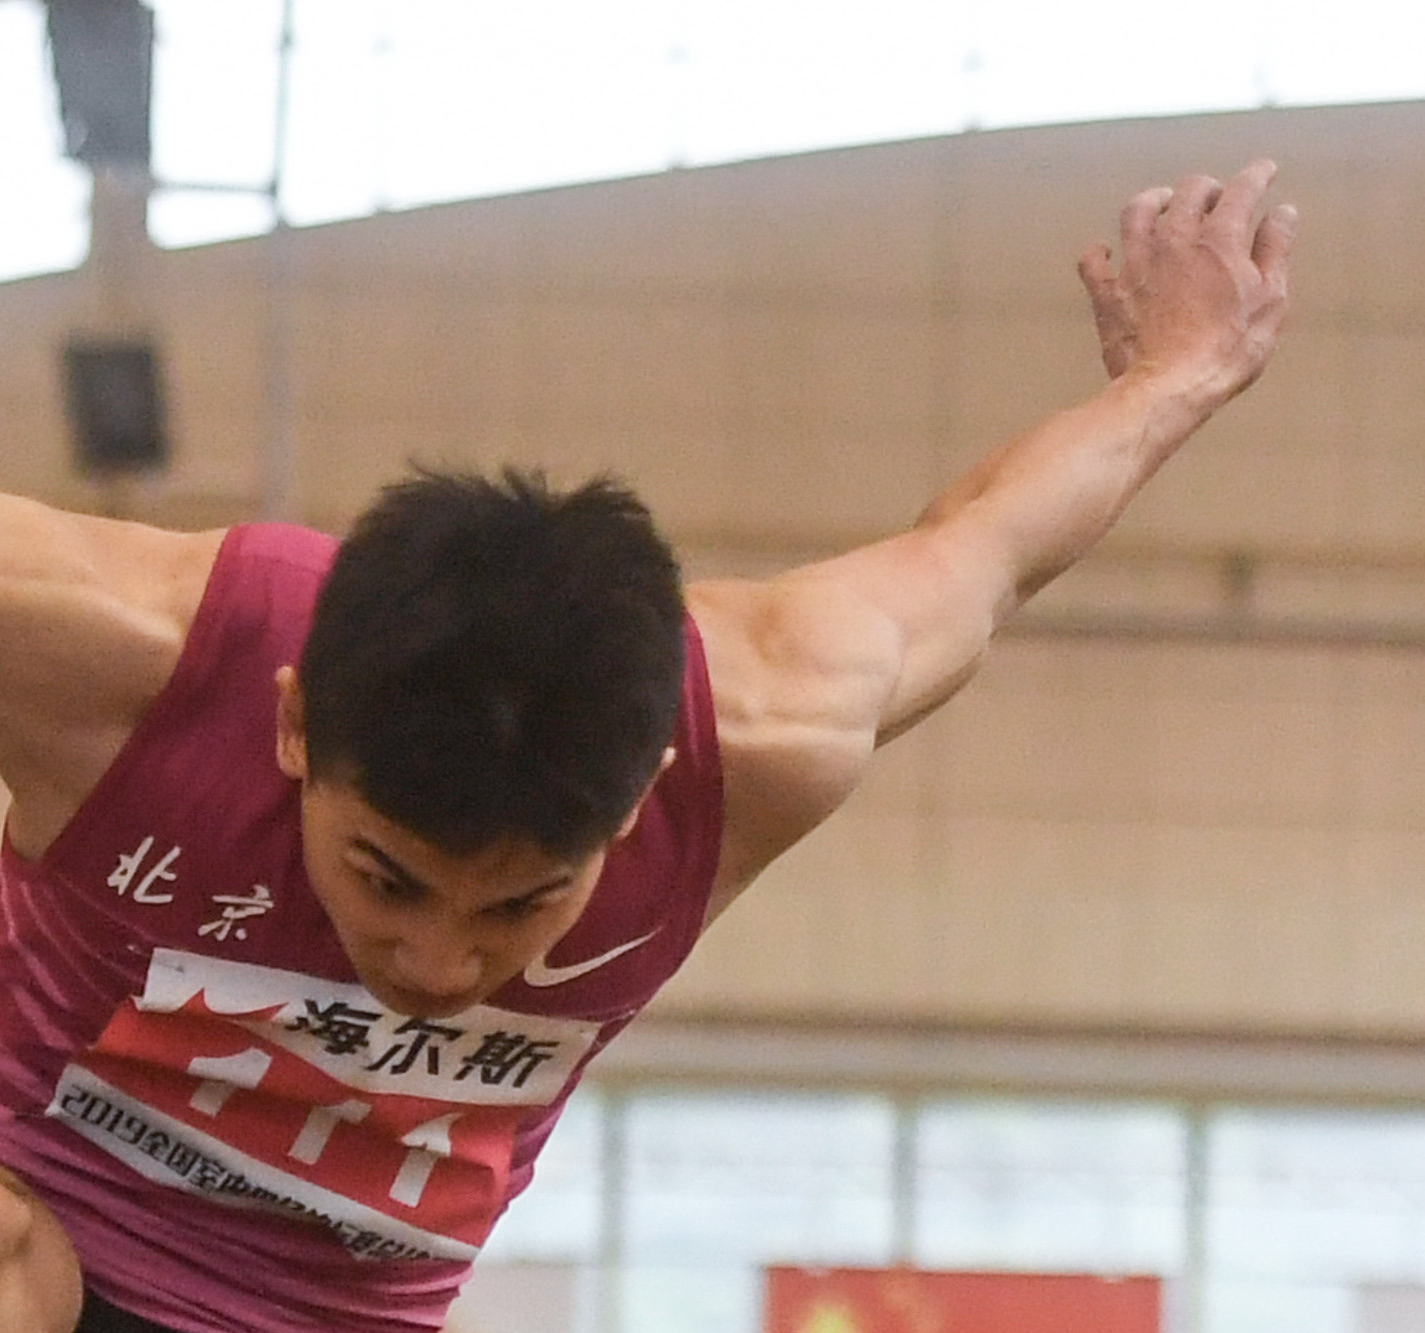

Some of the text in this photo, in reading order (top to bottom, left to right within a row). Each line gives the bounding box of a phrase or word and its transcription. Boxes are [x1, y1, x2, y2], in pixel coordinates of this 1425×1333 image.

[106, 834, 275, 942] 北京
[283, 998, 561, 1089] 海尔斯
